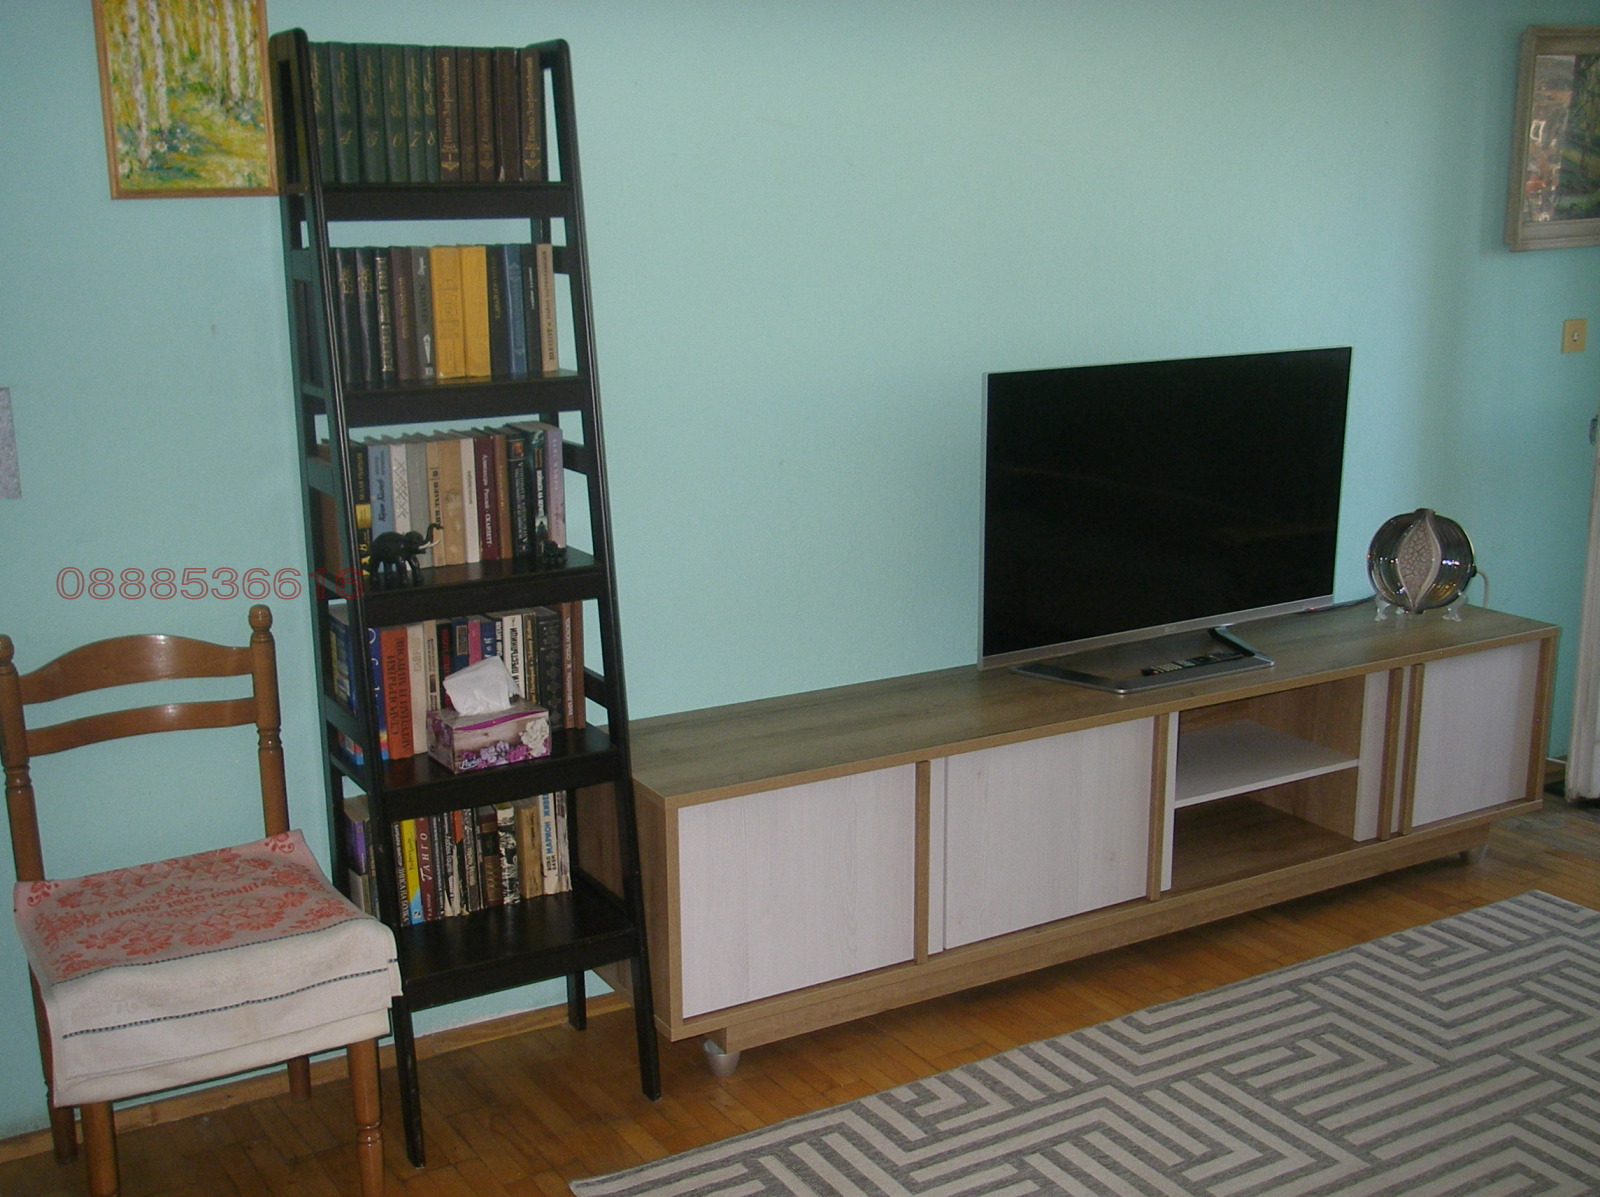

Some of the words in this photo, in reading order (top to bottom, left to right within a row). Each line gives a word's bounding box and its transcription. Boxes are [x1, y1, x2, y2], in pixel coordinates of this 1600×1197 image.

[340, 128, 352, 145] 4
[366, 130, 379, 147] 5
[392, 131, 402, 147] 6
[409, 130, 422, 147] 7
[397, 637, 407, 686] МИТОВЕ
[509, 627, 519, 674] ПРЕСТЪПНИЦИ
[387, 655, 399, 735] СТАРОГРЪЦКИ
[400, 700, 410, 749] ЛЕГЕНДИ
[544, 821, 553, 854] МАРИОН
